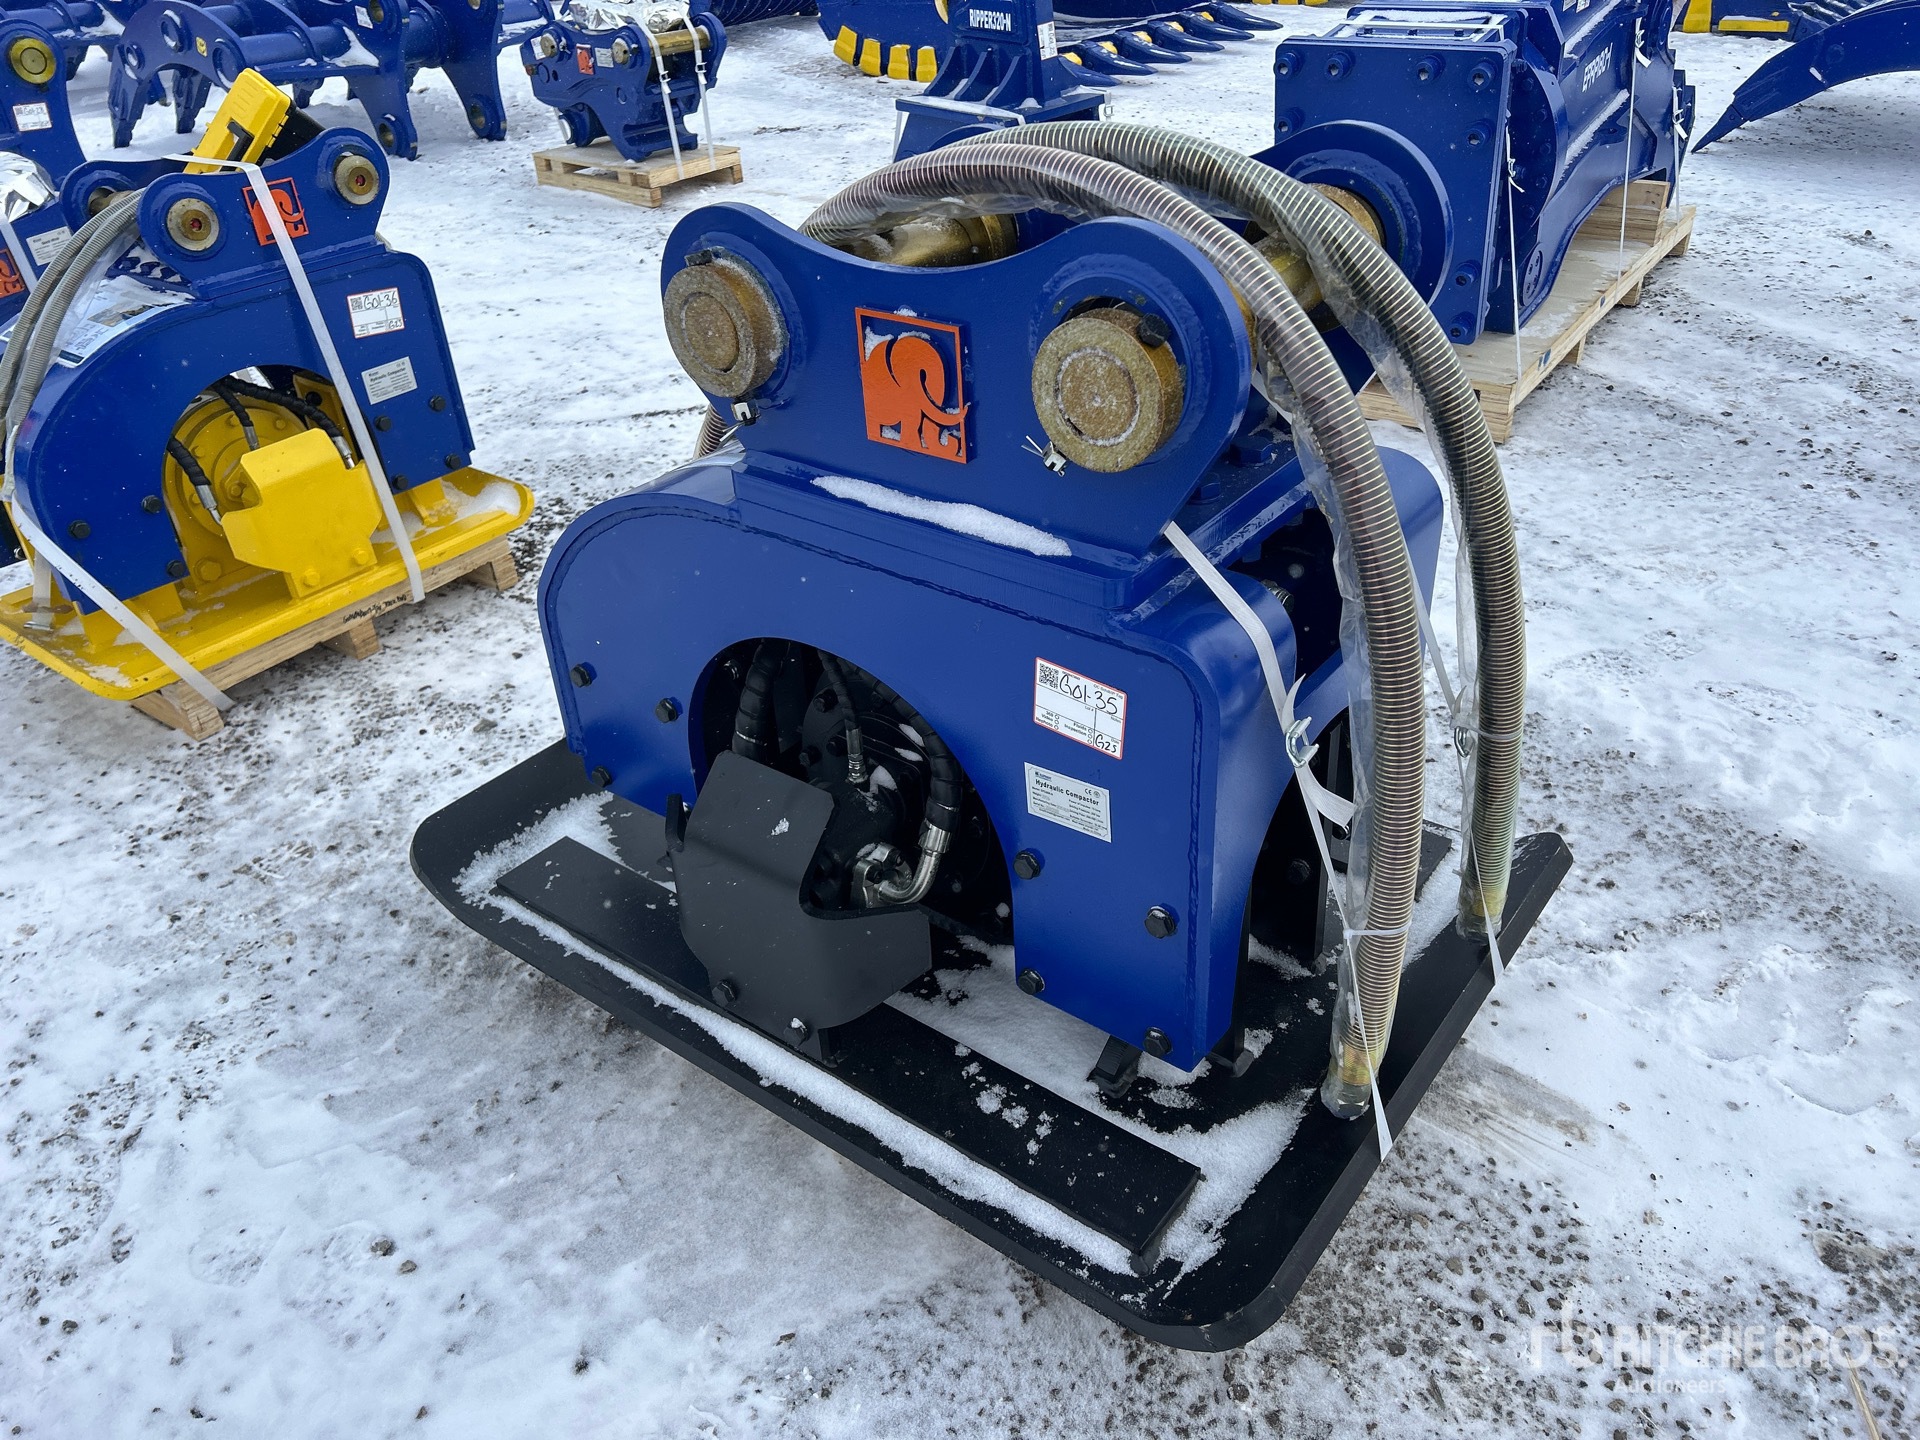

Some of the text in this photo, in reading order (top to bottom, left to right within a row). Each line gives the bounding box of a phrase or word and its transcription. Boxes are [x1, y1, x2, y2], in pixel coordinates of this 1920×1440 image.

[969, 8, 1012, 32] RIPPER320-N
[1035, 778, 1064, 794] Hydraulic
[1065, 789, 1100, 806] Compactor
